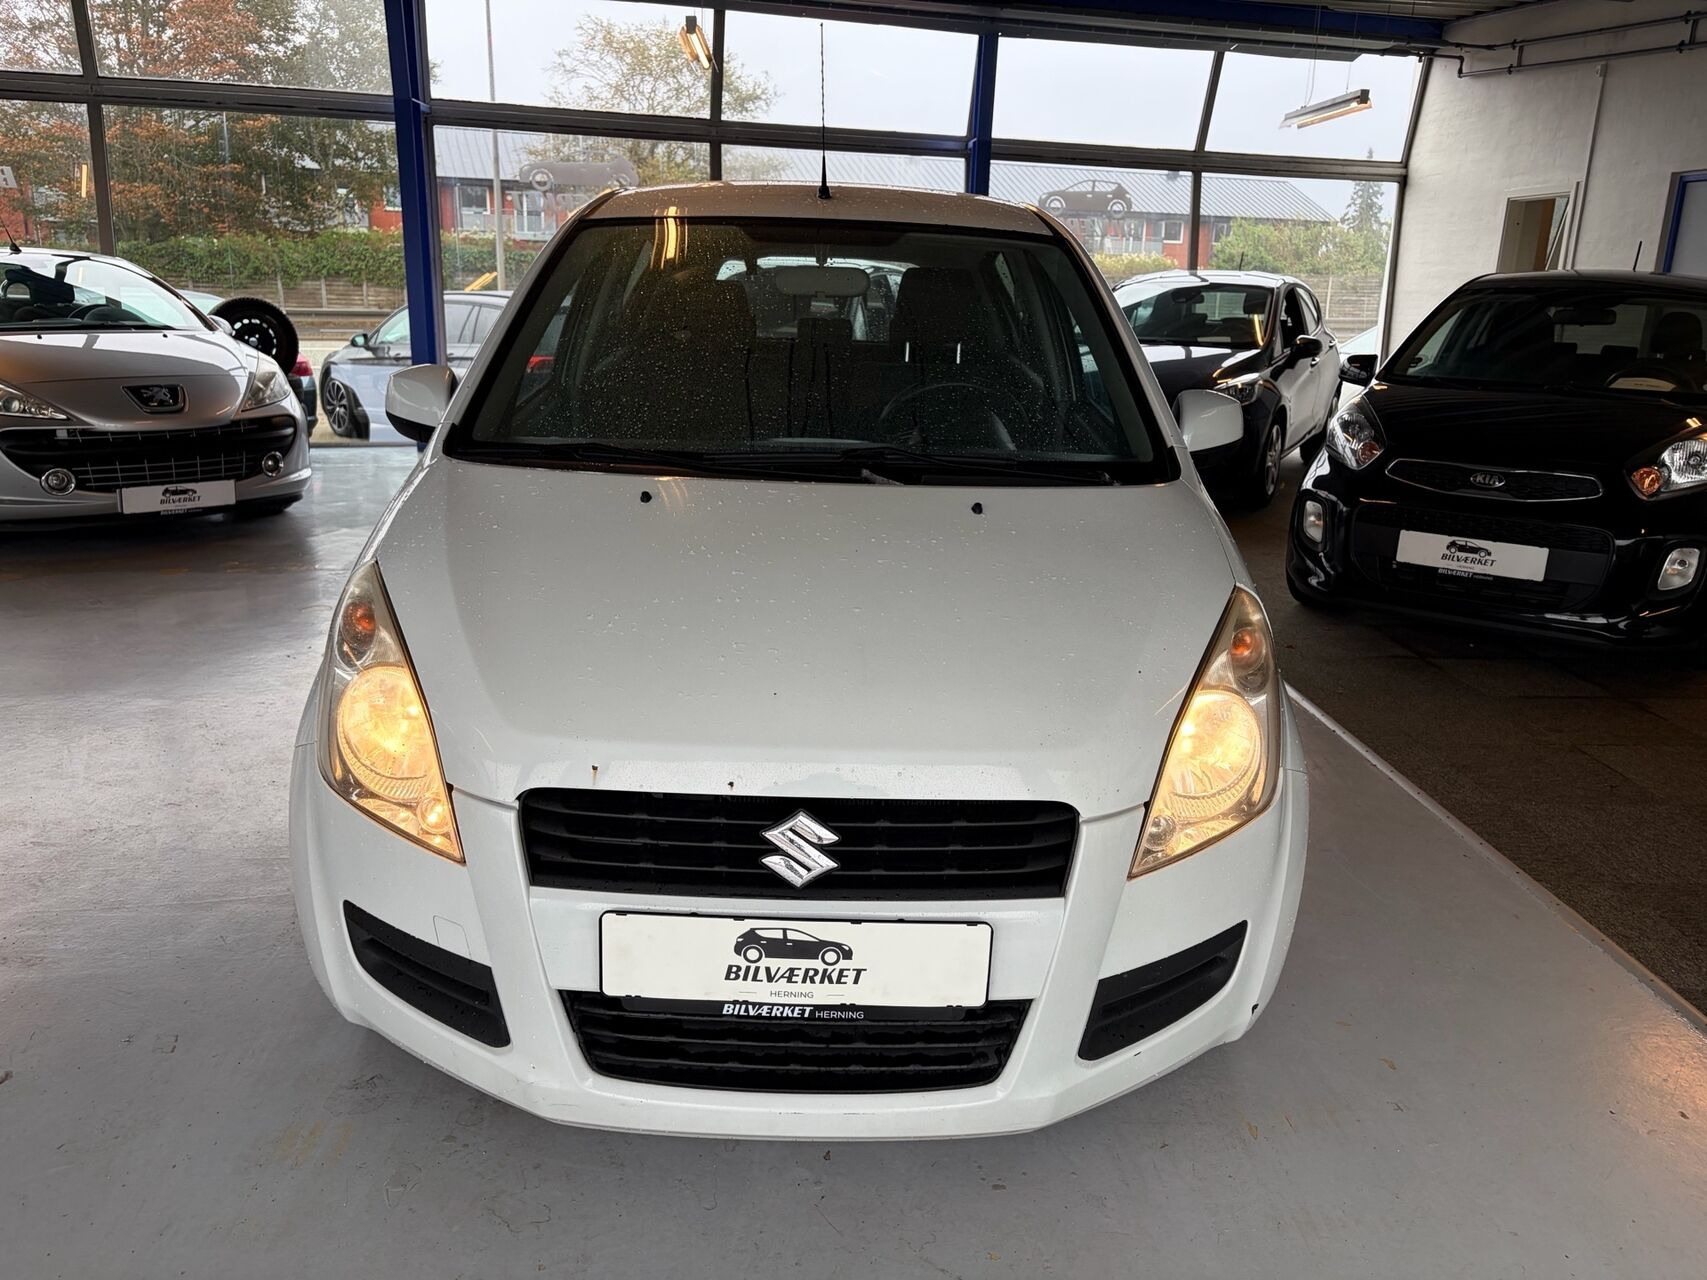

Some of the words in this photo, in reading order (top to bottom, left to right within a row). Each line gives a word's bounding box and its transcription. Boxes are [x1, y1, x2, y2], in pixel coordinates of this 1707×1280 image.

[1476, 474, 1499, 485] KIA
[1441, 553, 1496, 567] BILVÆRKET
[724, 964, 867, 985] BILVÆRKET
[770, 990, 814, 999] HERNING
[722, 1003, 814, 1018] BILVÆRKET
[815, 1010, 864, 1019] HERNING
